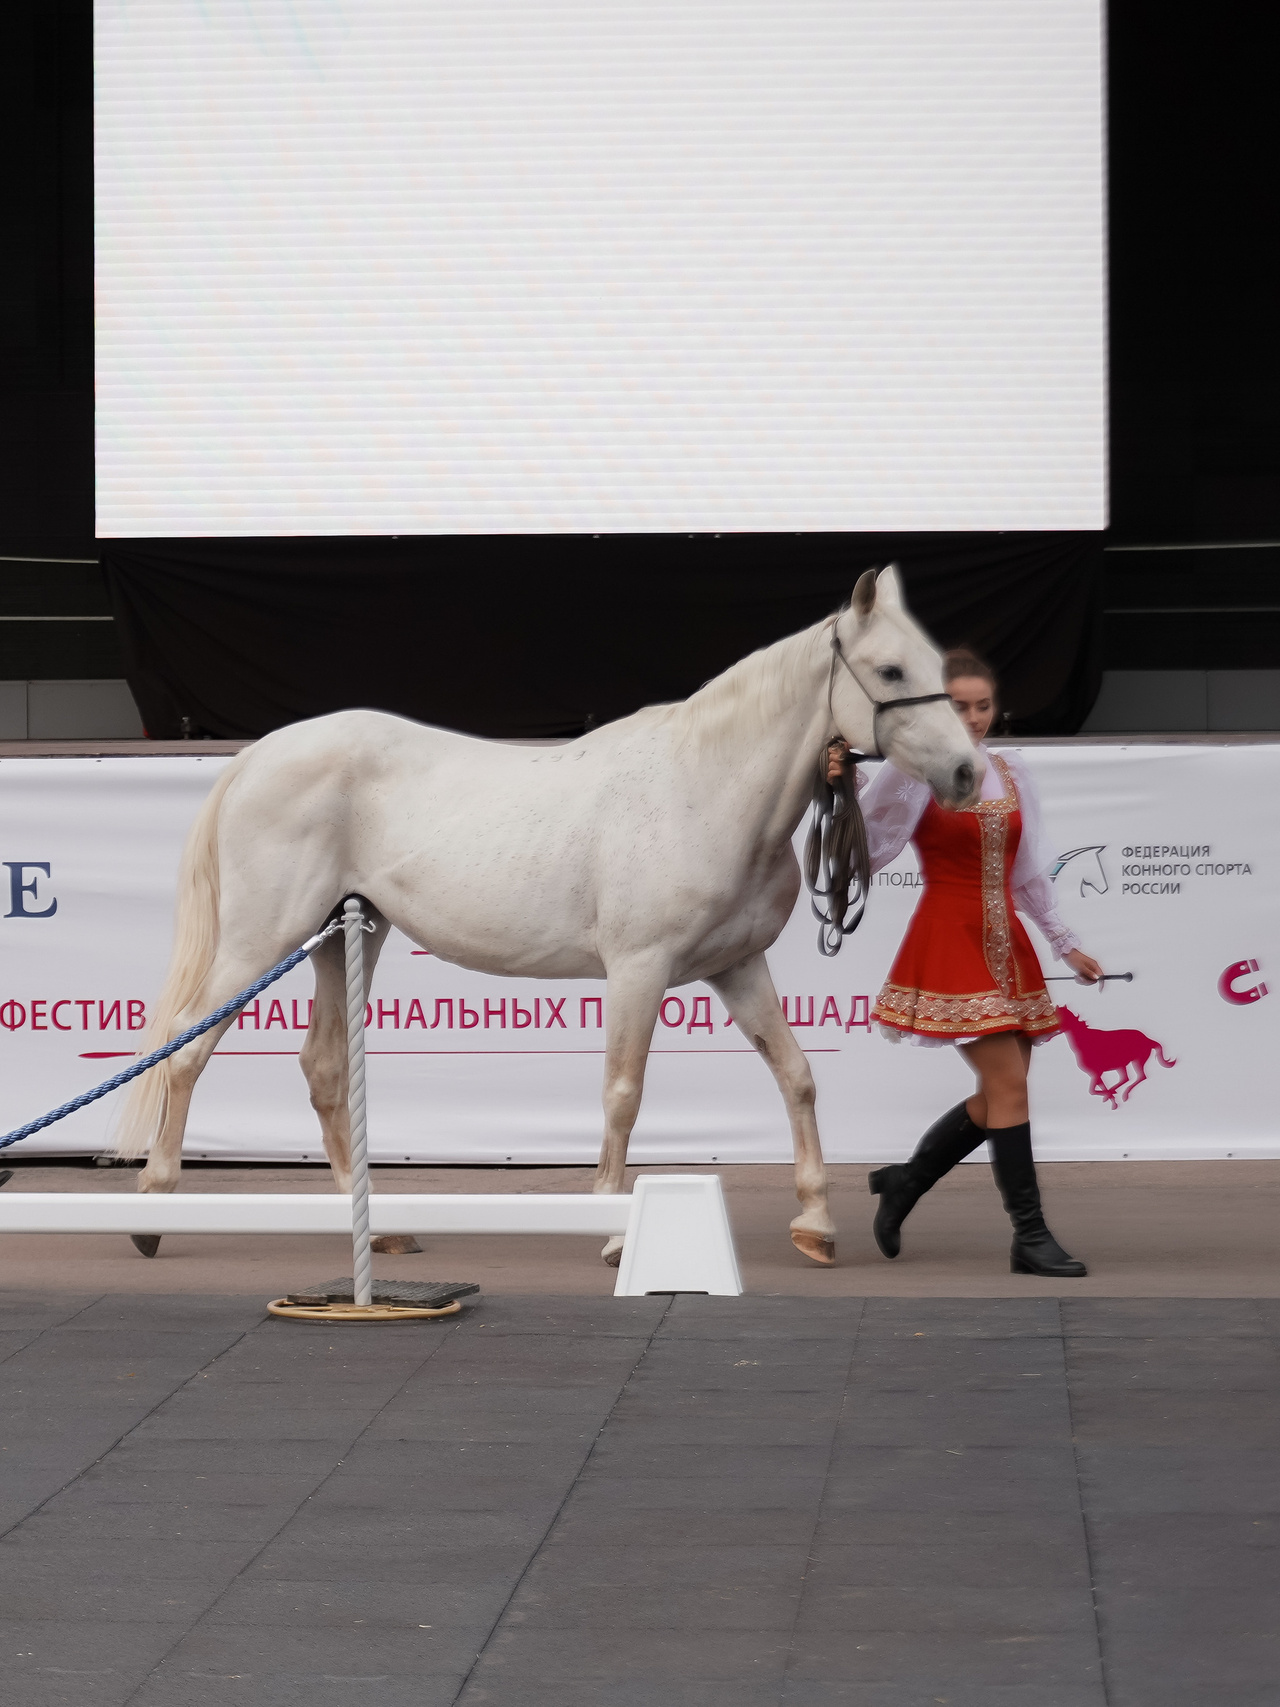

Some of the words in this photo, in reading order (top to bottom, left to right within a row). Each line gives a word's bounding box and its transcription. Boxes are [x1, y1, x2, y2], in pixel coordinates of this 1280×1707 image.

[1121, 845, 1211, 859] ФЕДЕРАЦИЯ
[1122, 864, 1191, 877] КОННОГО
[1195, 863, 1252, 876] СПОРТА
[878, 872, 924, 889] ПОДД
[1122, 882, 1182, 895] РОССИИ
[237, 997, 567, 1030] НАЦНАЛЬНЫХ
[580, 996, 713, 1035] ПОД
[724, 995, 872, 1034] ШАД
